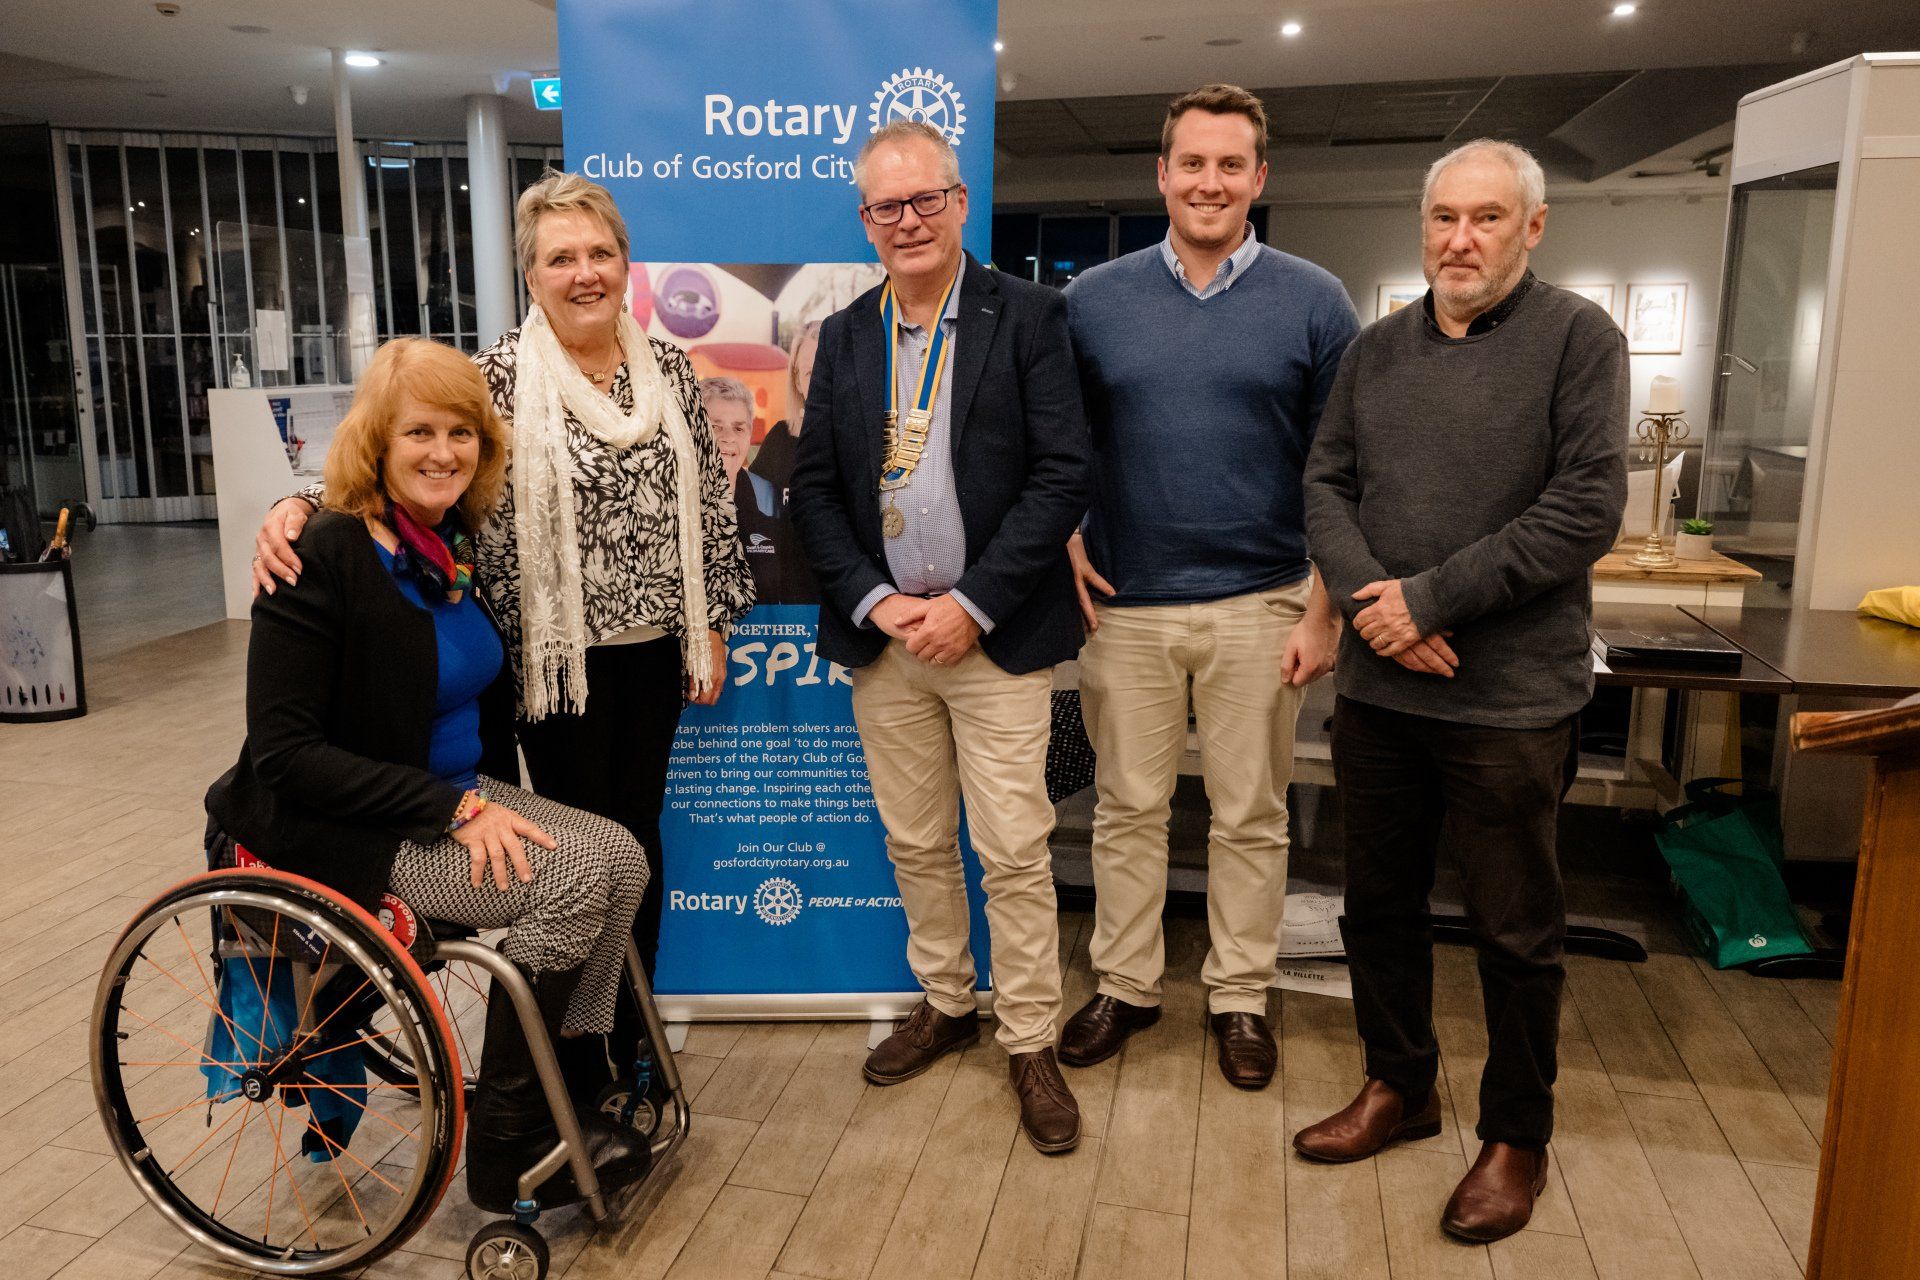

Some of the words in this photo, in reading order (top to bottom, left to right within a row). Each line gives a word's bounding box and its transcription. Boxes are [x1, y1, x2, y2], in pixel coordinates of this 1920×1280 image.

[898, 78, 938, 91] ROTARY
[706, 95, 857, 144] Rotary
[583, 153, 642, 179] Club
[654, 154, 682, 178] of
[693, 155, 800, 179] Gosford
[811, 154, 856, 185] City
[704, 723, 739, 734] unites
[741, 722, 789, 736] problem
[792, 722, 831, 733] solvers
[698, 737, 738, 749] behind
[740, 740, 763, 748] one
[765, 737, 791, 751] goal
[813, 737, 828, 748] do
[668, 753, 721, 764] members
[724, 752, 737, 764] of
[739, 752, 759, 763] the
[762, 753, 800, 766] Rotary
[802, 752, 828, 763] Club
[831, 752, 844, 763] of
[666, 769, 702, 780] driven
[704, 769, 718, 779] to
[720, 768, 751, 781] bring
[753, 770, 774, 778] our
[776, 767, 848, 778] communities
[675, 783, 712, 796] lasting
[715, 782, 760, 796] change.
[763, 782, 812, 796] Inspiring
[814, 782, 841, 793] each
[671, 801, 691, 809] our
[694, 798, 762, 809] connections
[763, 798, 777, 808] to
[780, 797, 811, 808] make
[813, 797, 849, 810] things
[726, 812, 756, 823] what
[759, 812, 798, 825] people
[801, 812, 814, 823] of
[816, 812, 851, 823] action
[854, 812, 872, 823] do.
[736, 842, 759, 853] Join
[762, 842, 785, 853] Our
[787, 841, 813, 852] Club
[815, 842, 826, 853] @
[713, 856, 849, 870] gosfordcityrotary.org.au
[671, 891, 747, 914] Rotary
[808, 897, 852, 907] PEOPLE
[854, 898, 866, 906] OF
[866, 897, 904, 907] ACTIO
[397, 903, 413, 922] FOR
[1293, 971, 1325, 981] VILLETTE
